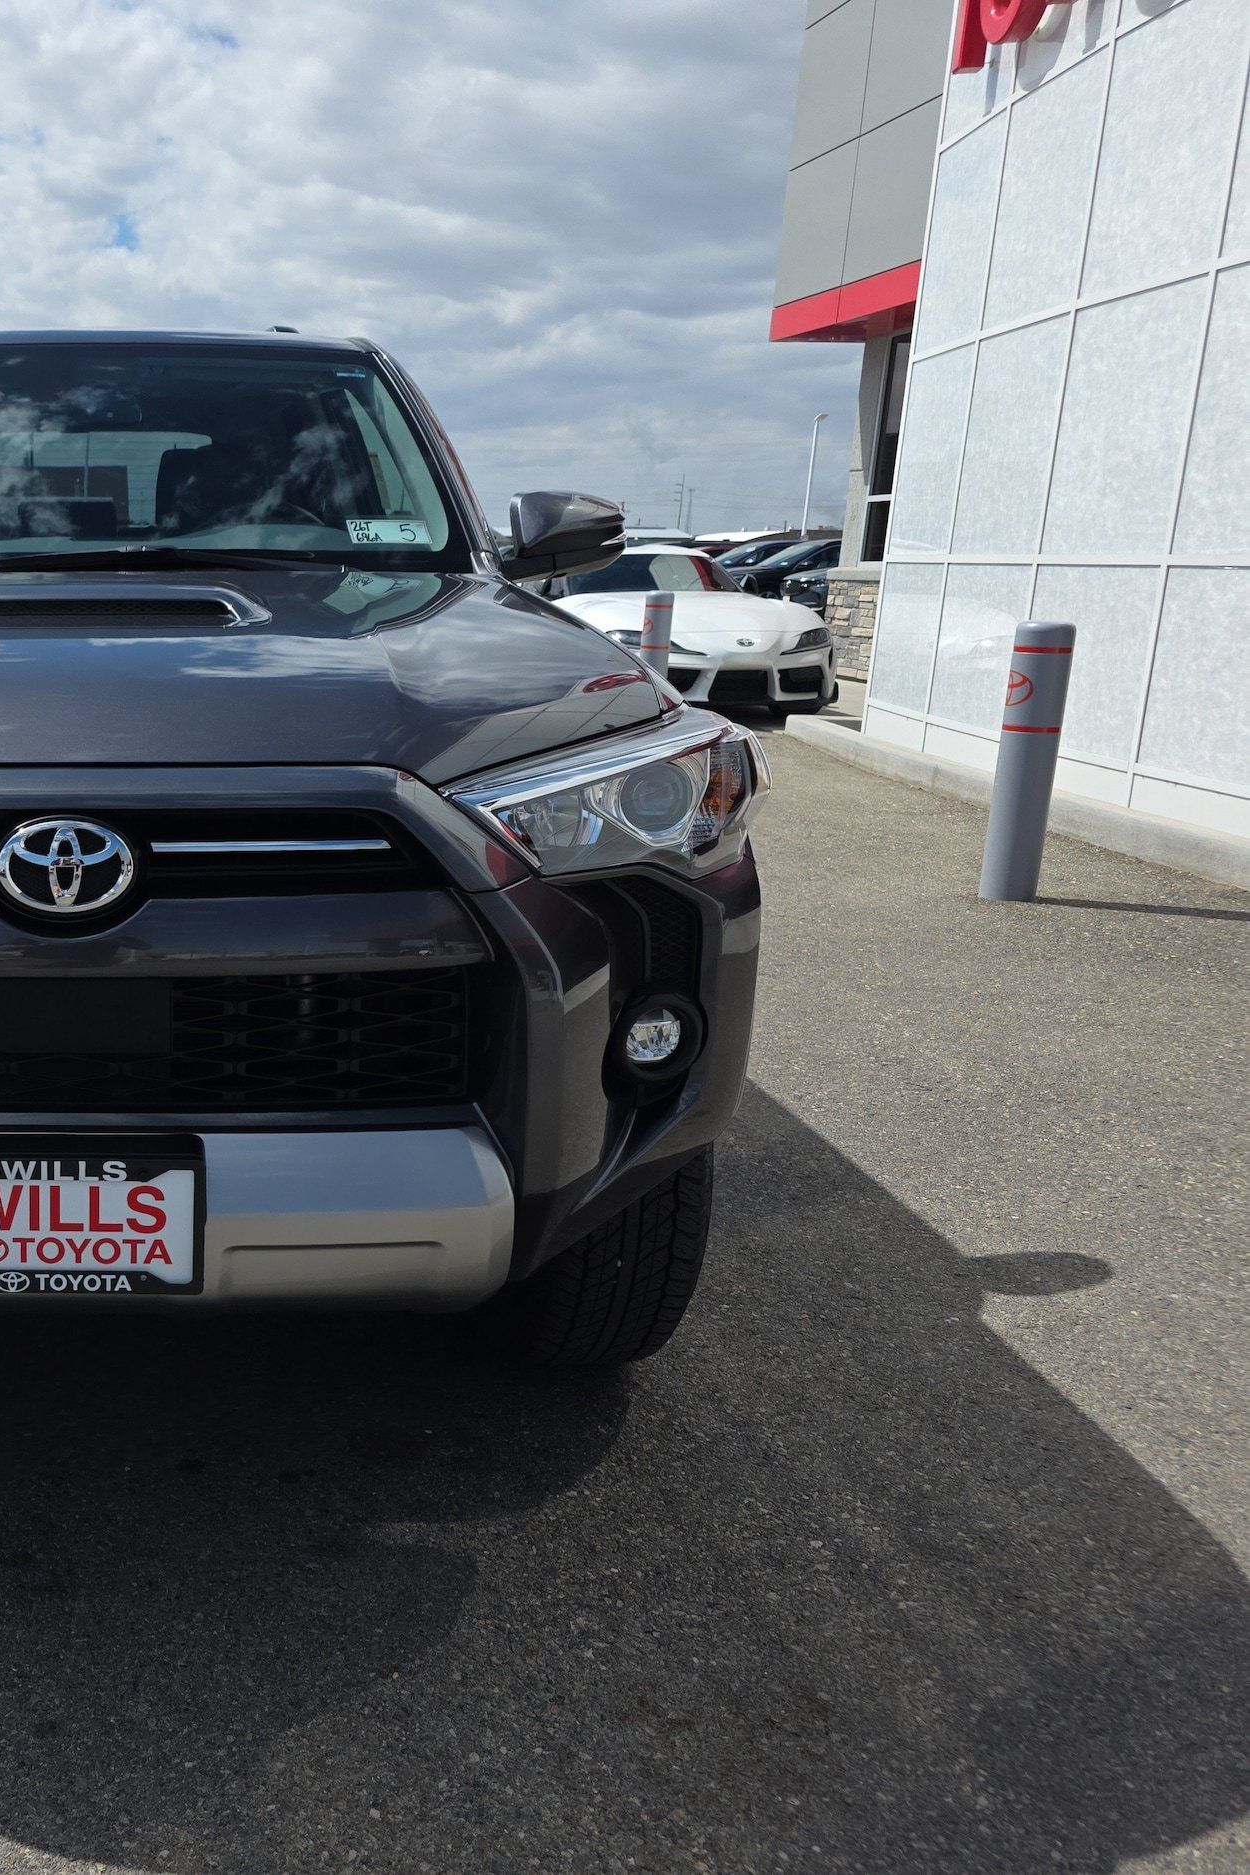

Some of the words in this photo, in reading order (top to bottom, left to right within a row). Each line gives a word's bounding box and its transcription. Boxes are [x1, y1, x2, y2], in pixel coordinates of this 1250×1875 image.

[399, 523, 417, 542] 5
[1, 1160, 127, 1182] WILLS
[12, 1237, 173, 1265] TOYOTA
[35, 1274, 132, 1292] TOYOTA
